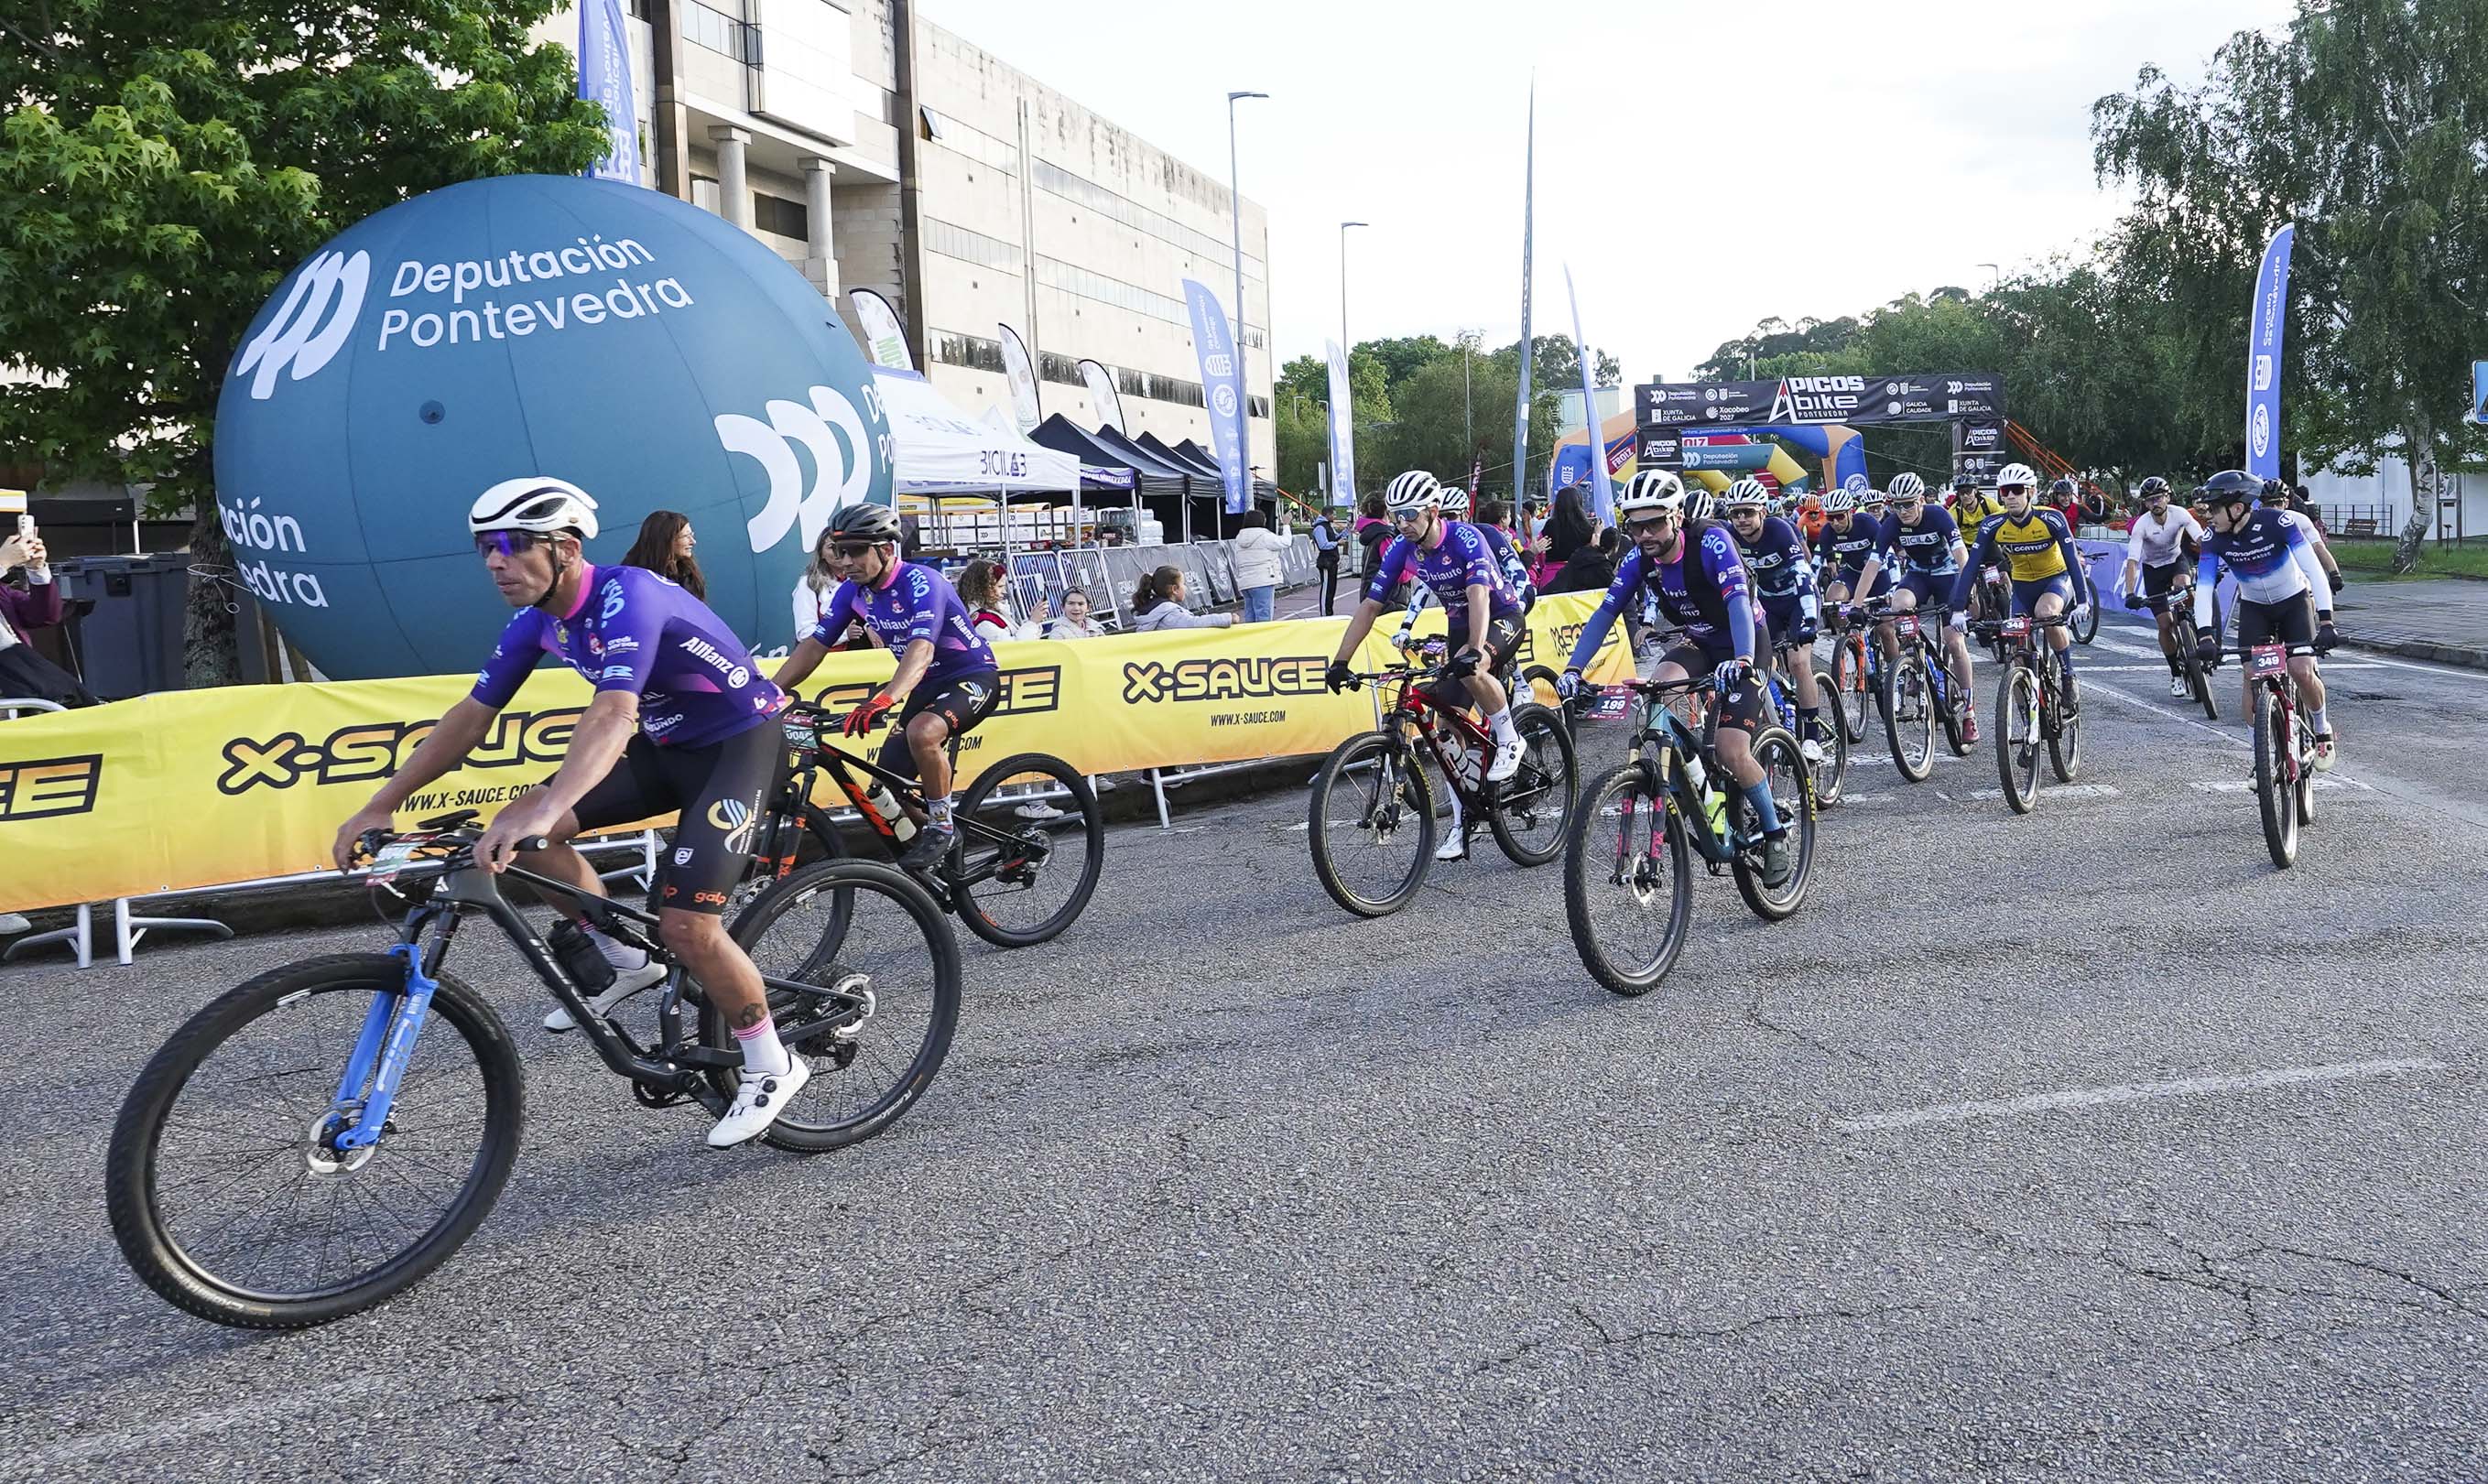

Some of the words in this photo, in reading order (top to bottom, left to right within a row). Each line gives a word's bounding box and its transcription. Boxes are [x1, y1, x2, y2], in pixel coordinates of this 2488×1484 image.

[389, 233, 655, 303] Deputación
[377, 274, 693, 351] Pontevedra
[1788, 375, 1865, 393] PICOS
[1793, 394, 1858, 410] bike
[1612, 448, 1634, 470] FROIZ
[679, 636, 734, 674] Allianz
[2258, 655, 2279, 667] 349
[1123, 656, 1329, 704] X-SAUCE
[1601, 700, 1625, 710] 199
[1211, 710, 1286, 727] WWW.X-SAUCE.COM
[397, 783, 546, 814] WW.X-SAUCE.CO
